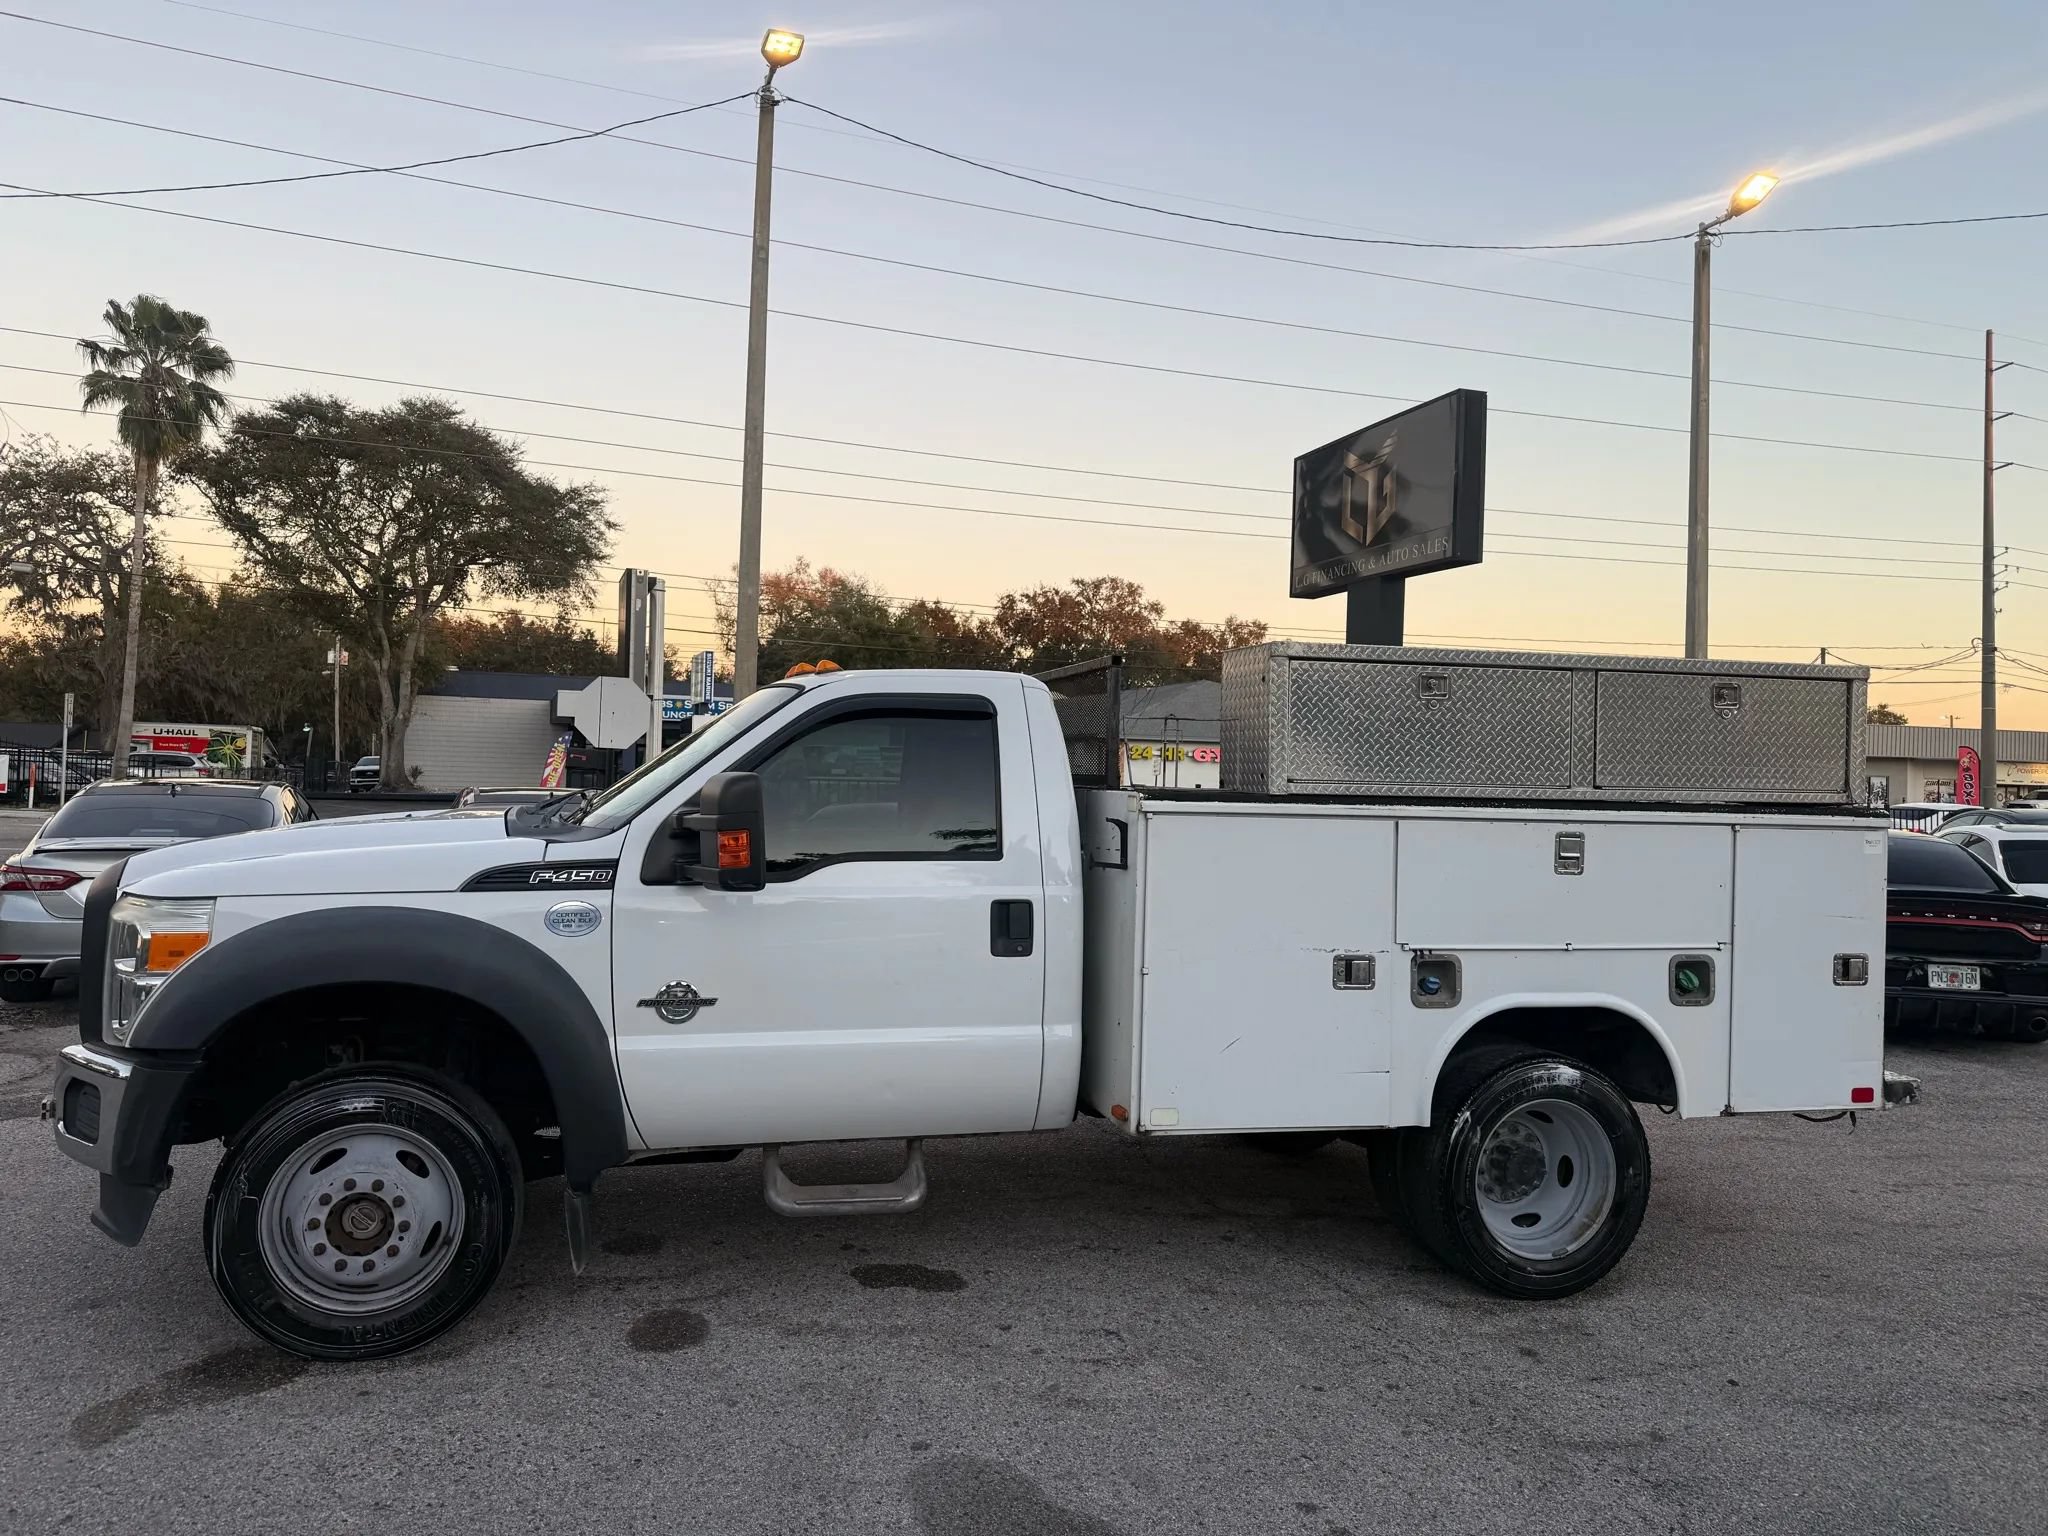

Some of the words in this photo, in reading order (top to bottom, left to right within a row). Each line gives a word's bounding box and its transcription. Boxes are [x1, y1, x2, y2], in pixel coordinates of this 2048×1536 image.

[1312, 558, 1366, 584] FINANCING
[1367, 558, 1377, 569] &
[1379, 546, 1409, 566] AUTO
[1412, 536, 1449, 559] SALES
[153, 728, 199, 736] U-HAUL
[1130, 745, 1153, 760] 24
[1160, 746, 1185, 761] HR
[529, 869, 613, 884] F-450
